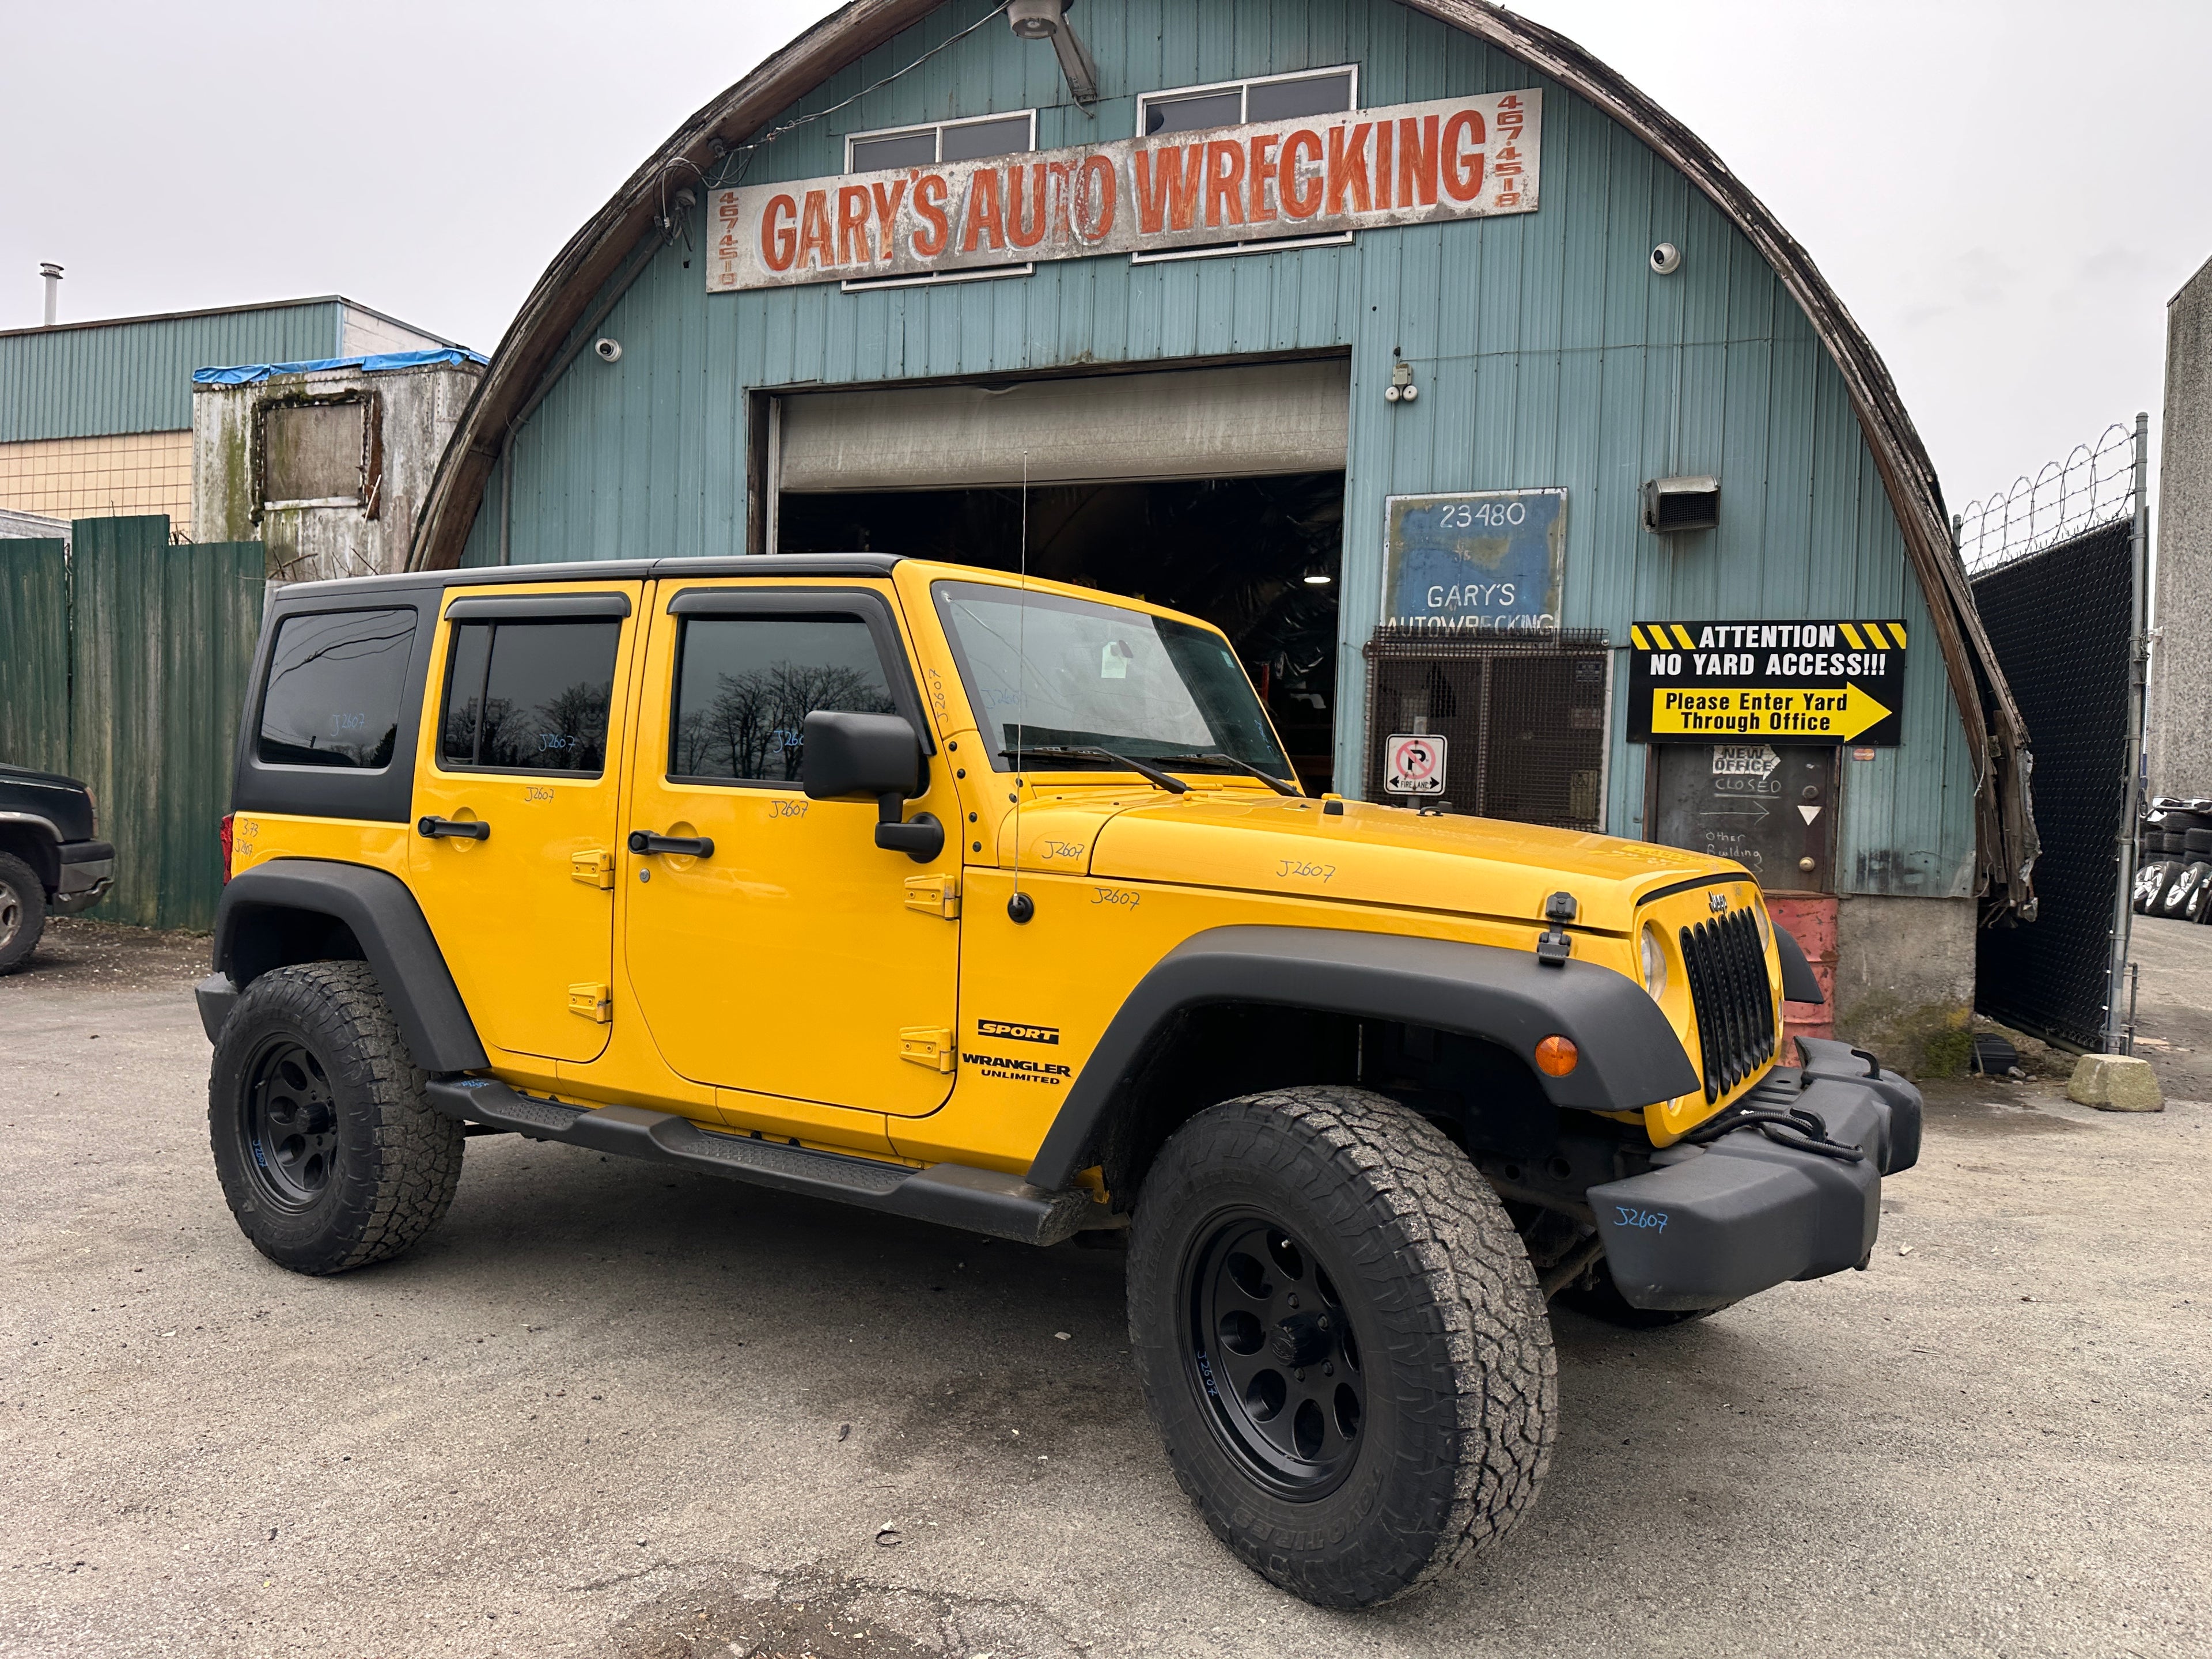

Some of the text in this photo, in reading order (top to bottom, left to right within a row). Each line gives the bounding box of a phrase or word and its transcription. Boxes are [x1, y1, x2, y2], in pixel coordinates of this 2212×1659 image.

[762, 109, 1486, 271] GARY'S AUTO WRECKING
[1440, 502, 1526, 528] 23480
[1427, 583, 1516, 608] GARY'S
[1699, 624, 1836, 649] ATTENTION
[1650, 653, 1886, 676] NO YARD ACCESS!!!
[928, 668, 949, 724] J2607
[1665, 692, 1847, 711] Please Enter Yard
[330, 713, 365, 737] J2607
[1681, 712, 1831, 733] Through Office
[538, 733, 576, 753] J2607
[772, 730, 804, 753] J260
[1722, 748, 1765, 760] NEW
[1714, 759, 1774, 772] OFFICE
[524, 787, 554, 804] J2607
[1400, 781, 1412, 789] FIRE
[1715, 778, 1782, 793] CLOSED
[768, 800, 809, 819] J2607
[1041, 840, 1085, 861] J2607
[1706, 844, 1763, 864] Building
[1276, 859, 1336, 884] J2607
[1090, 887, 1140, 911] J2607
[978, 1022, 1059, 1041] SPORT
[962, 1052, 1073, 1078] WRANGLER
[981, 1069, 1060, 1085] UNLIMITED
[1613, 1206, 1668, 1234] J2607
[1197, 1350, 1218, 1396] J2607
